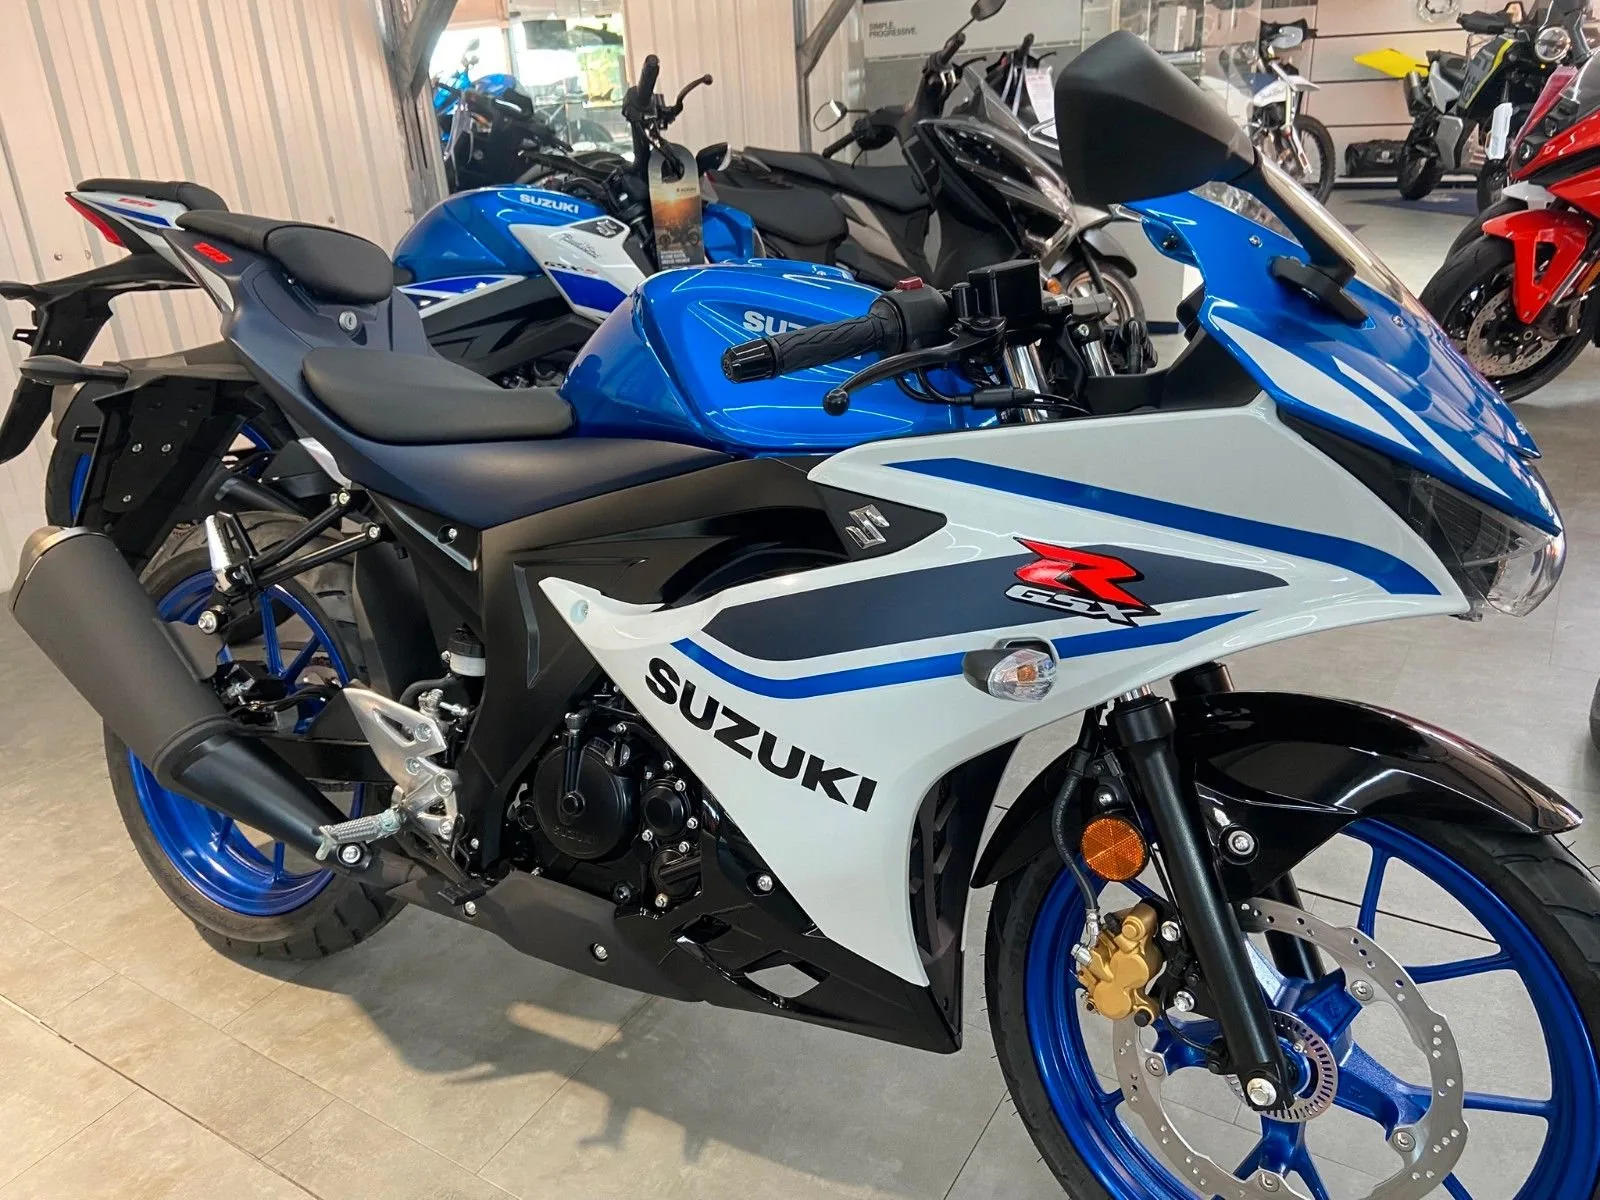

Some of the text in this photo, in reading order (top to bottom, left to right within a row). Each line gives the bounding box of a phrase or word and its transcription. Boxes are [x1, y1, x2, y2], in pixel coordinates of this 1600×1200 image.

[519, 193, 579, 214] SUZUKI
[193, 242, 233, 264] 125
[645, 657, 878, 813] SUZUKI
